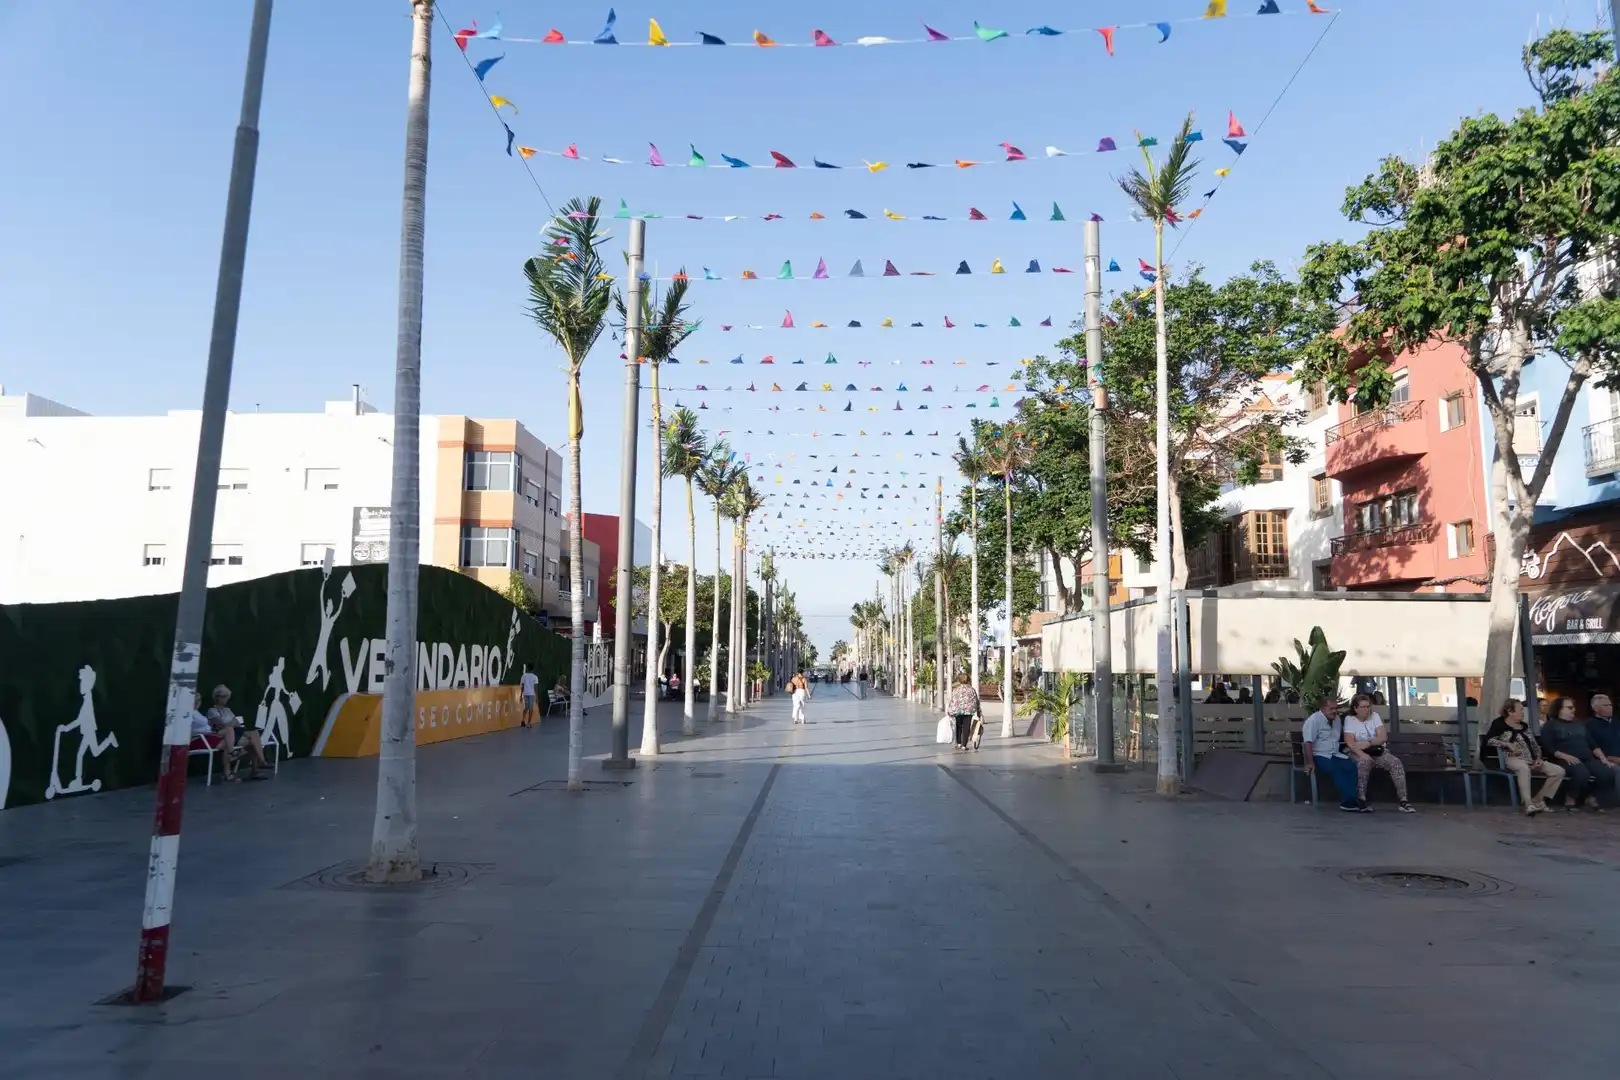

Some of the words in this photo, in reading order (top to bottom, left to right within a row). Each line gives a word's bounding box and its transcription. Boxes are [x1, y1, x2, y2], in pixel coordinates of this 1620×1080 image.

[1566, 619, 1579, 630] BAR
[1579, 618, 1585, 630] &
[1585, 617, 1603, 630] GRILL
[340, 637, 502, 694] VENDARIO
[419, 705, 450, 729] SEO
